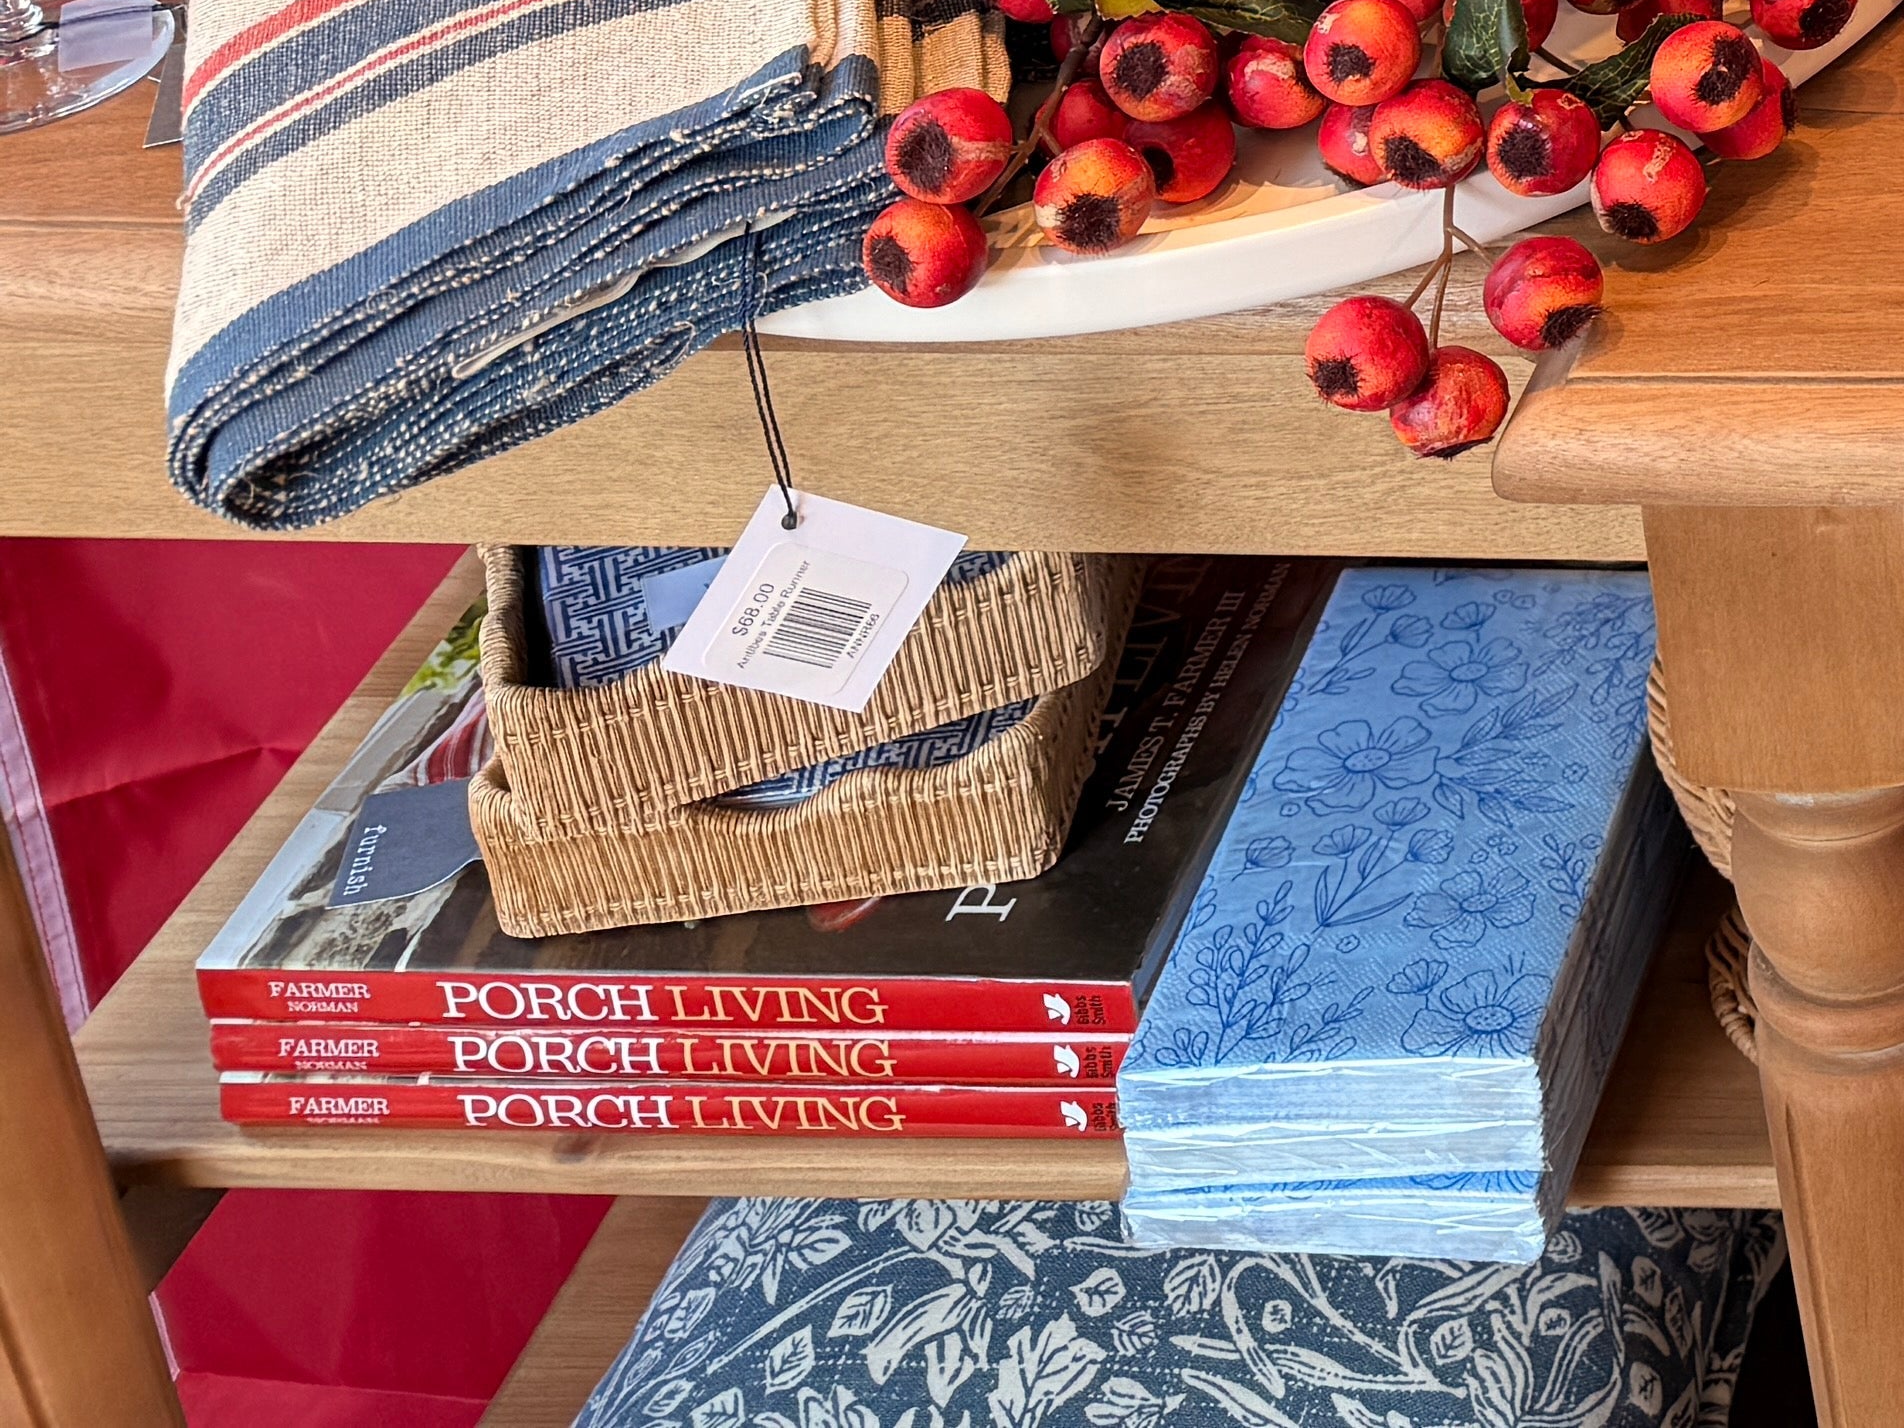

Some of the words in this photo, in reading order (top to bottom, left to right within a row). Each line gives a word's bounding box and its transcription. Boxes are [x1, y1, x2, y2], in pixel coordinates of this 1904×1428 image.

[780, 560, 810, 599] Runner
[732, 583, 774, 636] $68.00
[1105, 735, 1165, 812] JAMES
[1163, 616, 1232, 707] FARMER
[1124, 714, 1207, 845] PHOTOGRAPHS
[1194, 691, 1220, 715] BY
[1209, 633, 1253, 689] HELEN
[343, 825, 387, 895] furnish
[267, 981, 371, 999] FARMER
[288, 1001, 358, 1013] NORMAN
[435, 981, 659, 1021] PORCH
[665, 985, 889, 1024] LIVING
[278, 1038, 379, 1058] FARMER
[447, 1036, 669, 1074] PORCH
[676, 1038, 897, 1077] LIVING
[288, 1097, 390, 1116] FARMER
[457, 1094, 679, 1129] PORCH
[685, 1095, 906, 1131] LIVING
